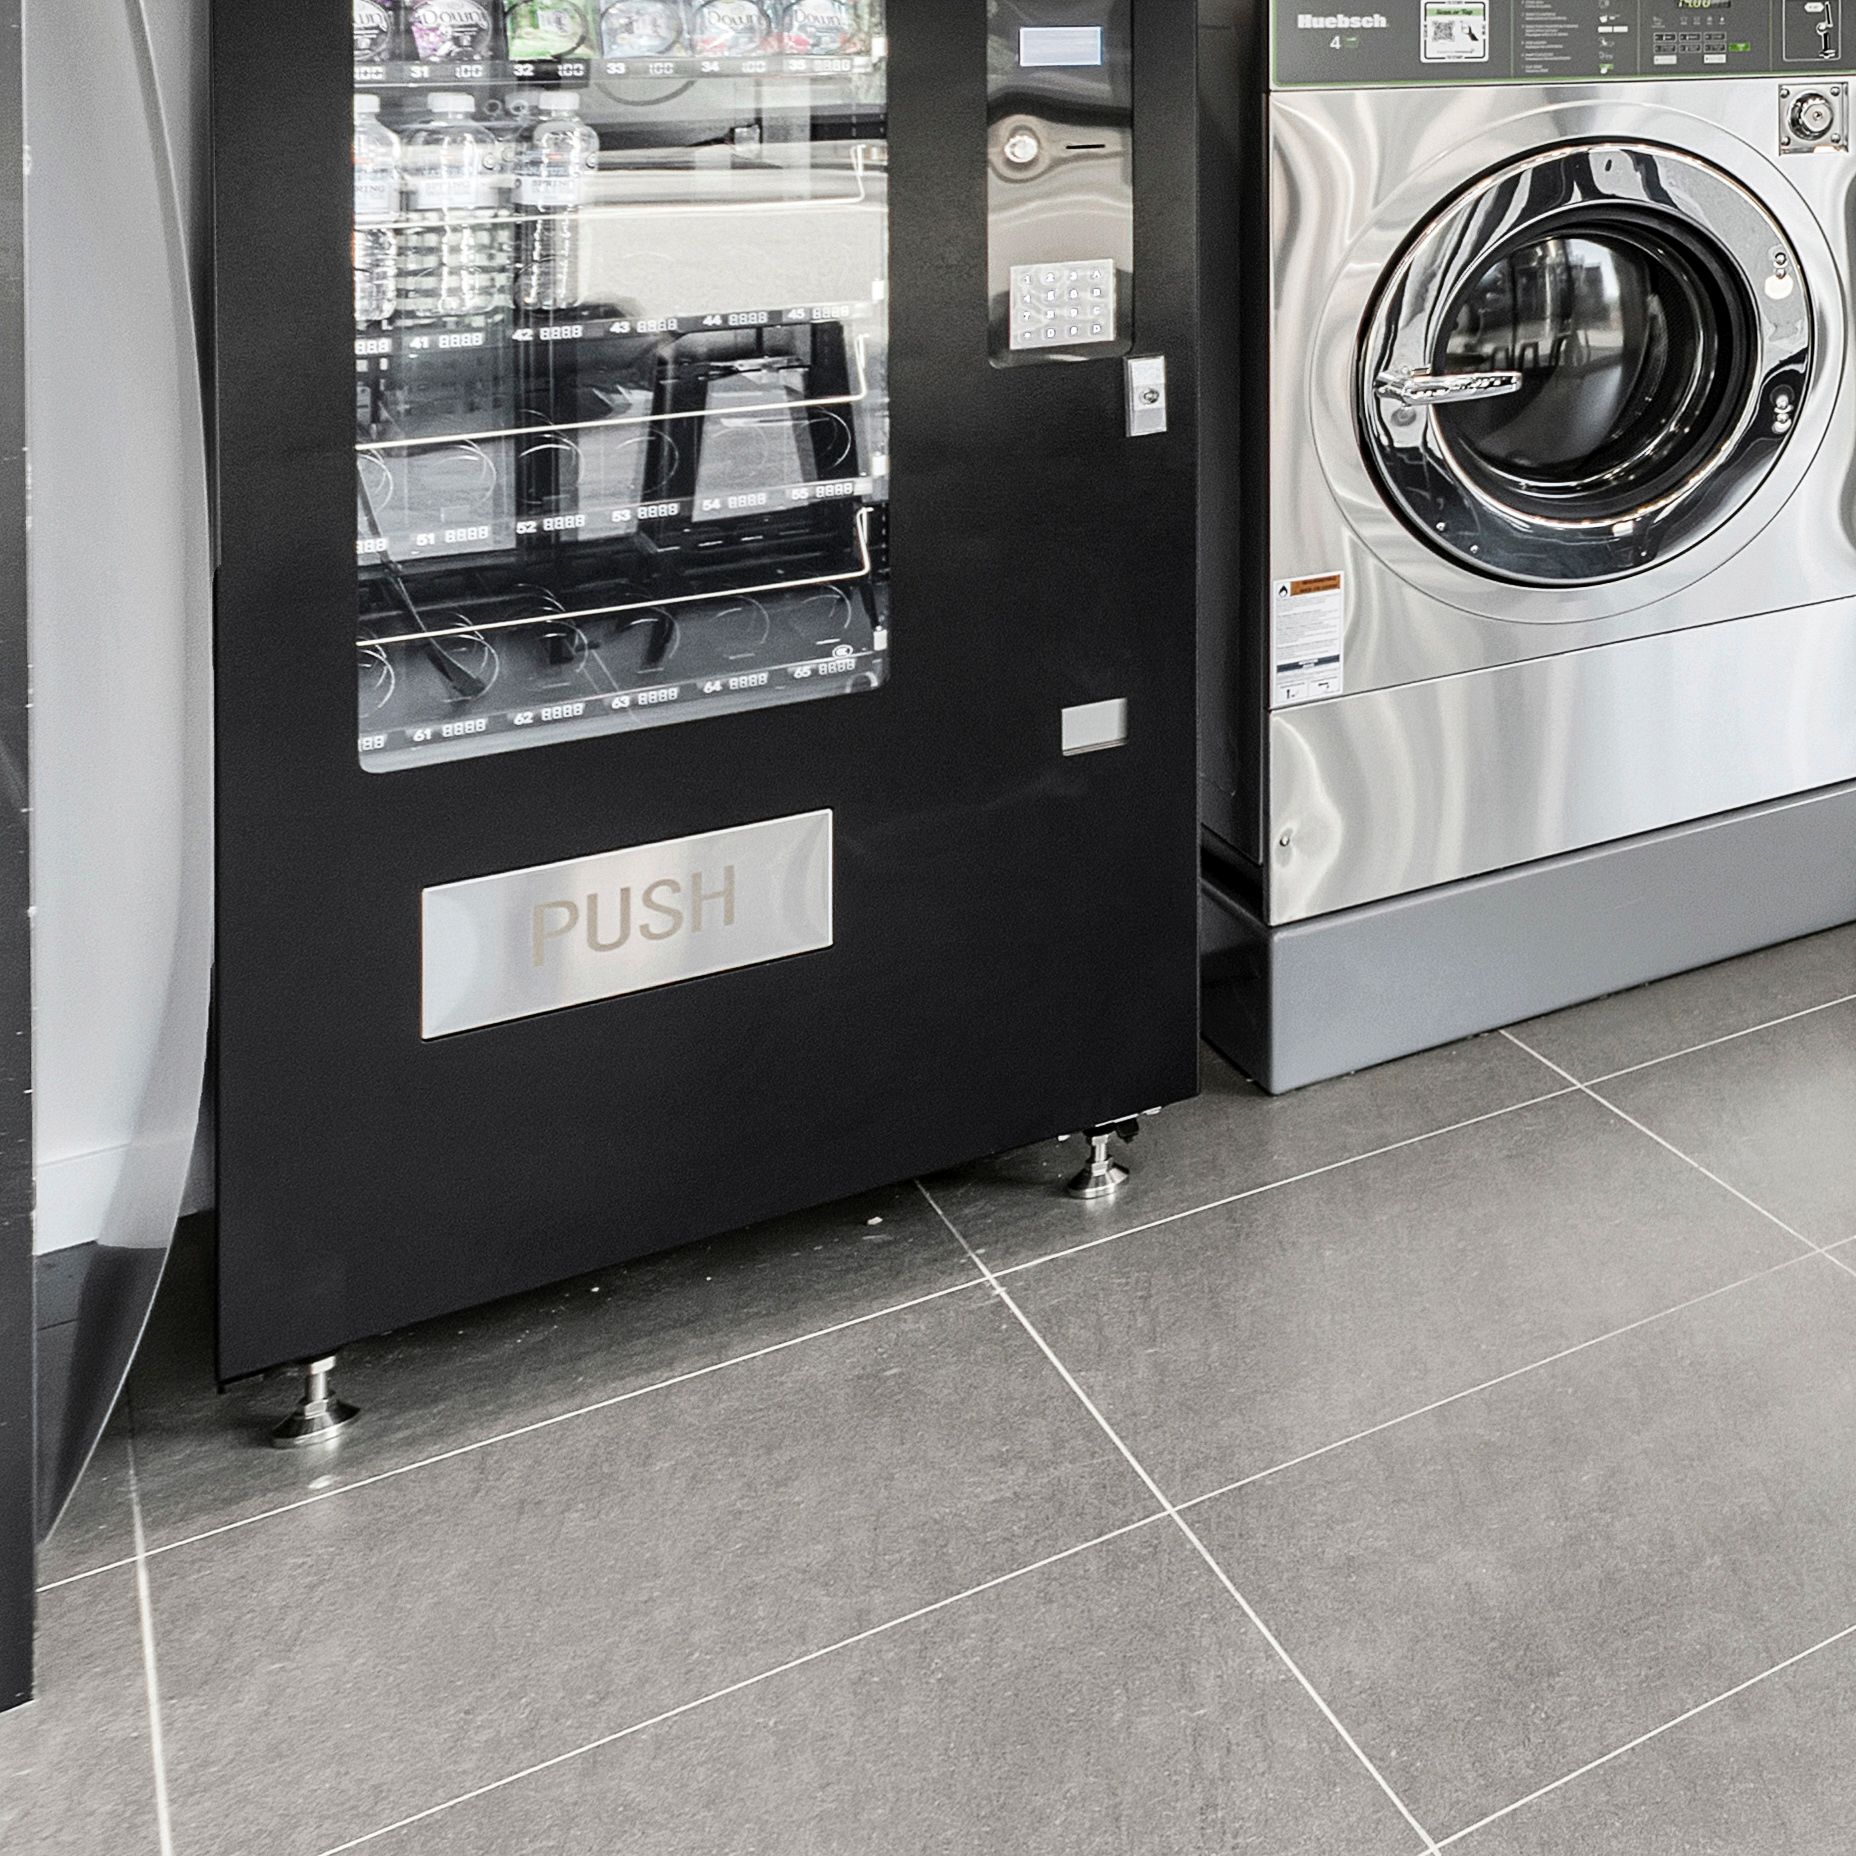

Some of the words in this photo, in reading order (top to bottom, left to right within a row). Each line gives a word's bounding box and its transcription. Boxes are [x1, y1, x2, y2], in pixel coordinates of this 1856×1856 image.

[1297, 13, 1388, 29] Huebsch
[1329, 36, 1341, 50] 4
[411, 66, 429, 78] 31
[513, 64, 534, 76] 32
[606, 63, 625, 74] 33
[701, 61, 719, 72] 34
[703, 314, 722, 326] 44
[788, 309, 805, 319] 45
[610, 321, 630, 333] 43
[512, 329, 533, 341] 42
[410, 337, 429, 349] 41
[791, 488, 809, 499] 55
[702, 499, 721, 510] 54
[612, 510, 631, 522] 53
[516, 521, 536, 534] 52
[417, 533, 435, 546] 51
[794, 666, 811, 678] 65
[704, 681, 722, 693] 64
[611, 696, 630, 709] 63
[514, 713, 533, 725] 62
[413, 729, 431, 742] 61
[530, 865, 737, 968] PUSH
